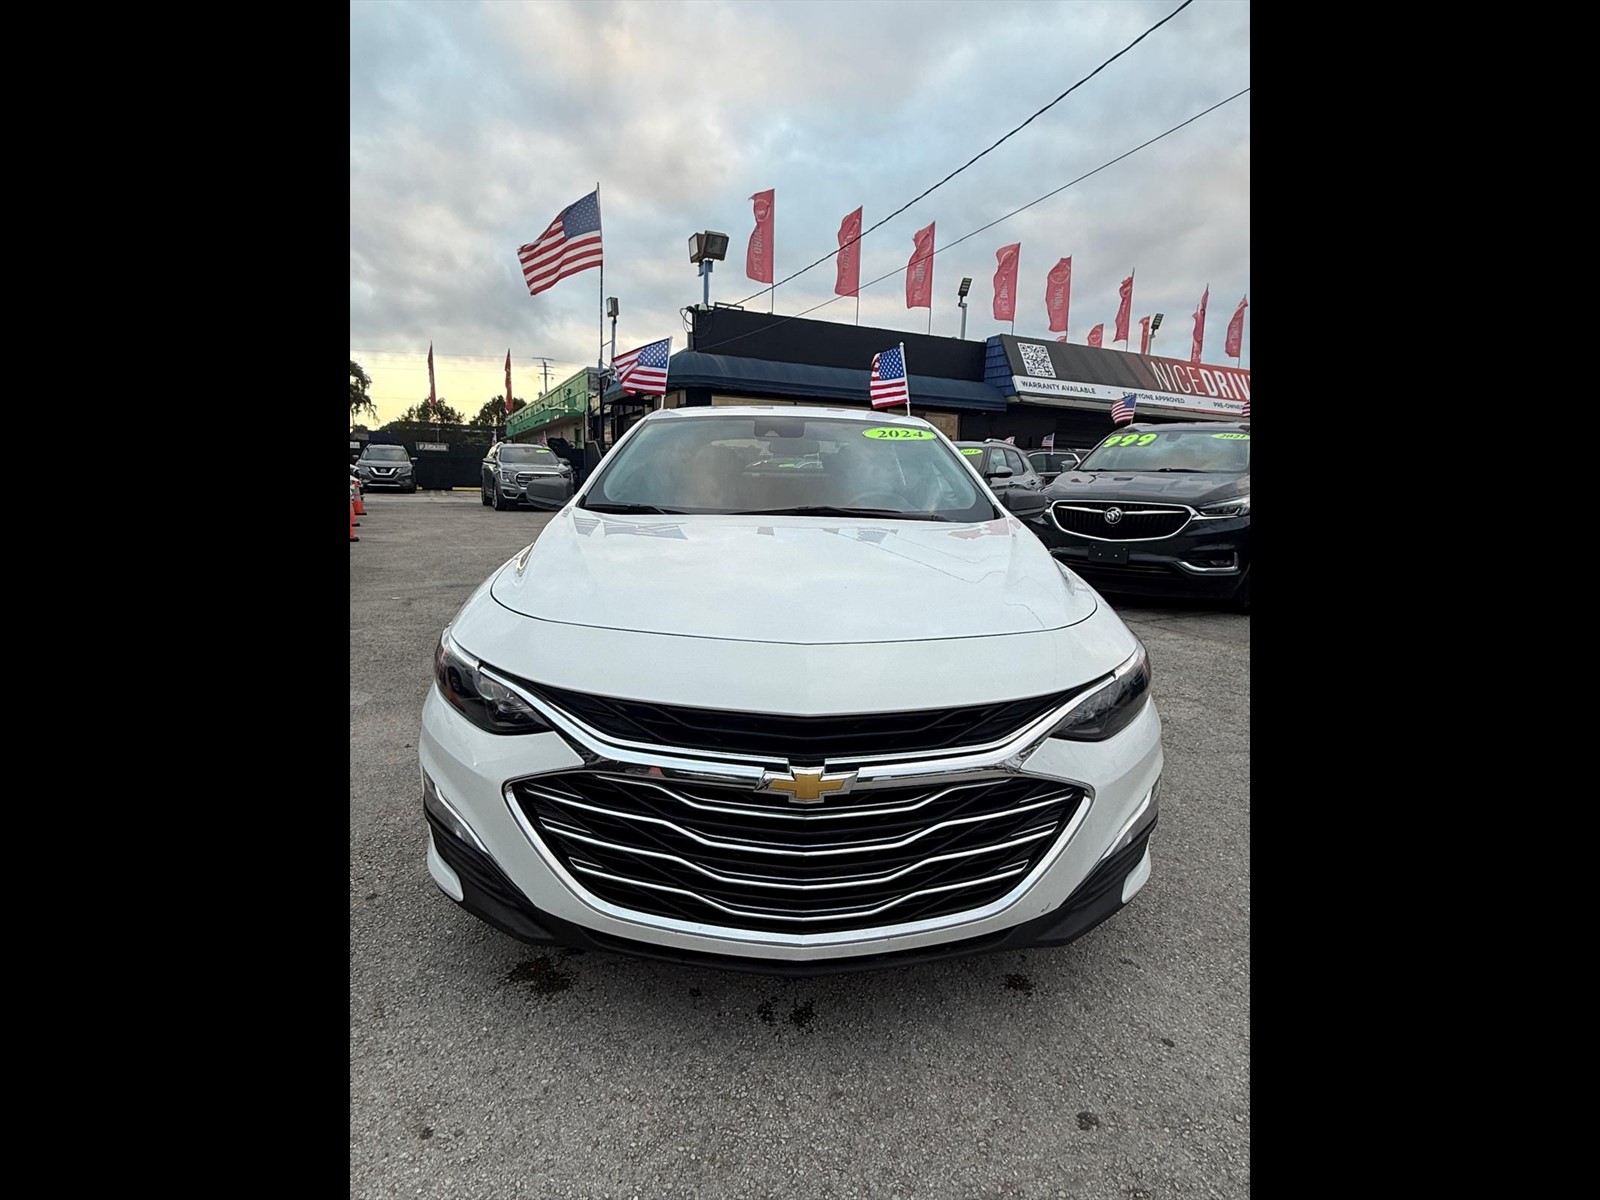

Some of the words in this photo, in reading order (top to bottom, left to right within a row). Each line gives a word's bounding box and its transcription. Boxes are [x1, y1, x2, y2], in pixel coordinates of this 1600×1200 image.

[1020, 380, 1060, 391] WARRANTY
[1061, 384, 1096, 394] AVAILABLE
[1155, 394, 1185, 404] APPROVED
[877, 430, 924, 438] 2024
[1102, 432, 1158, 448] 999
